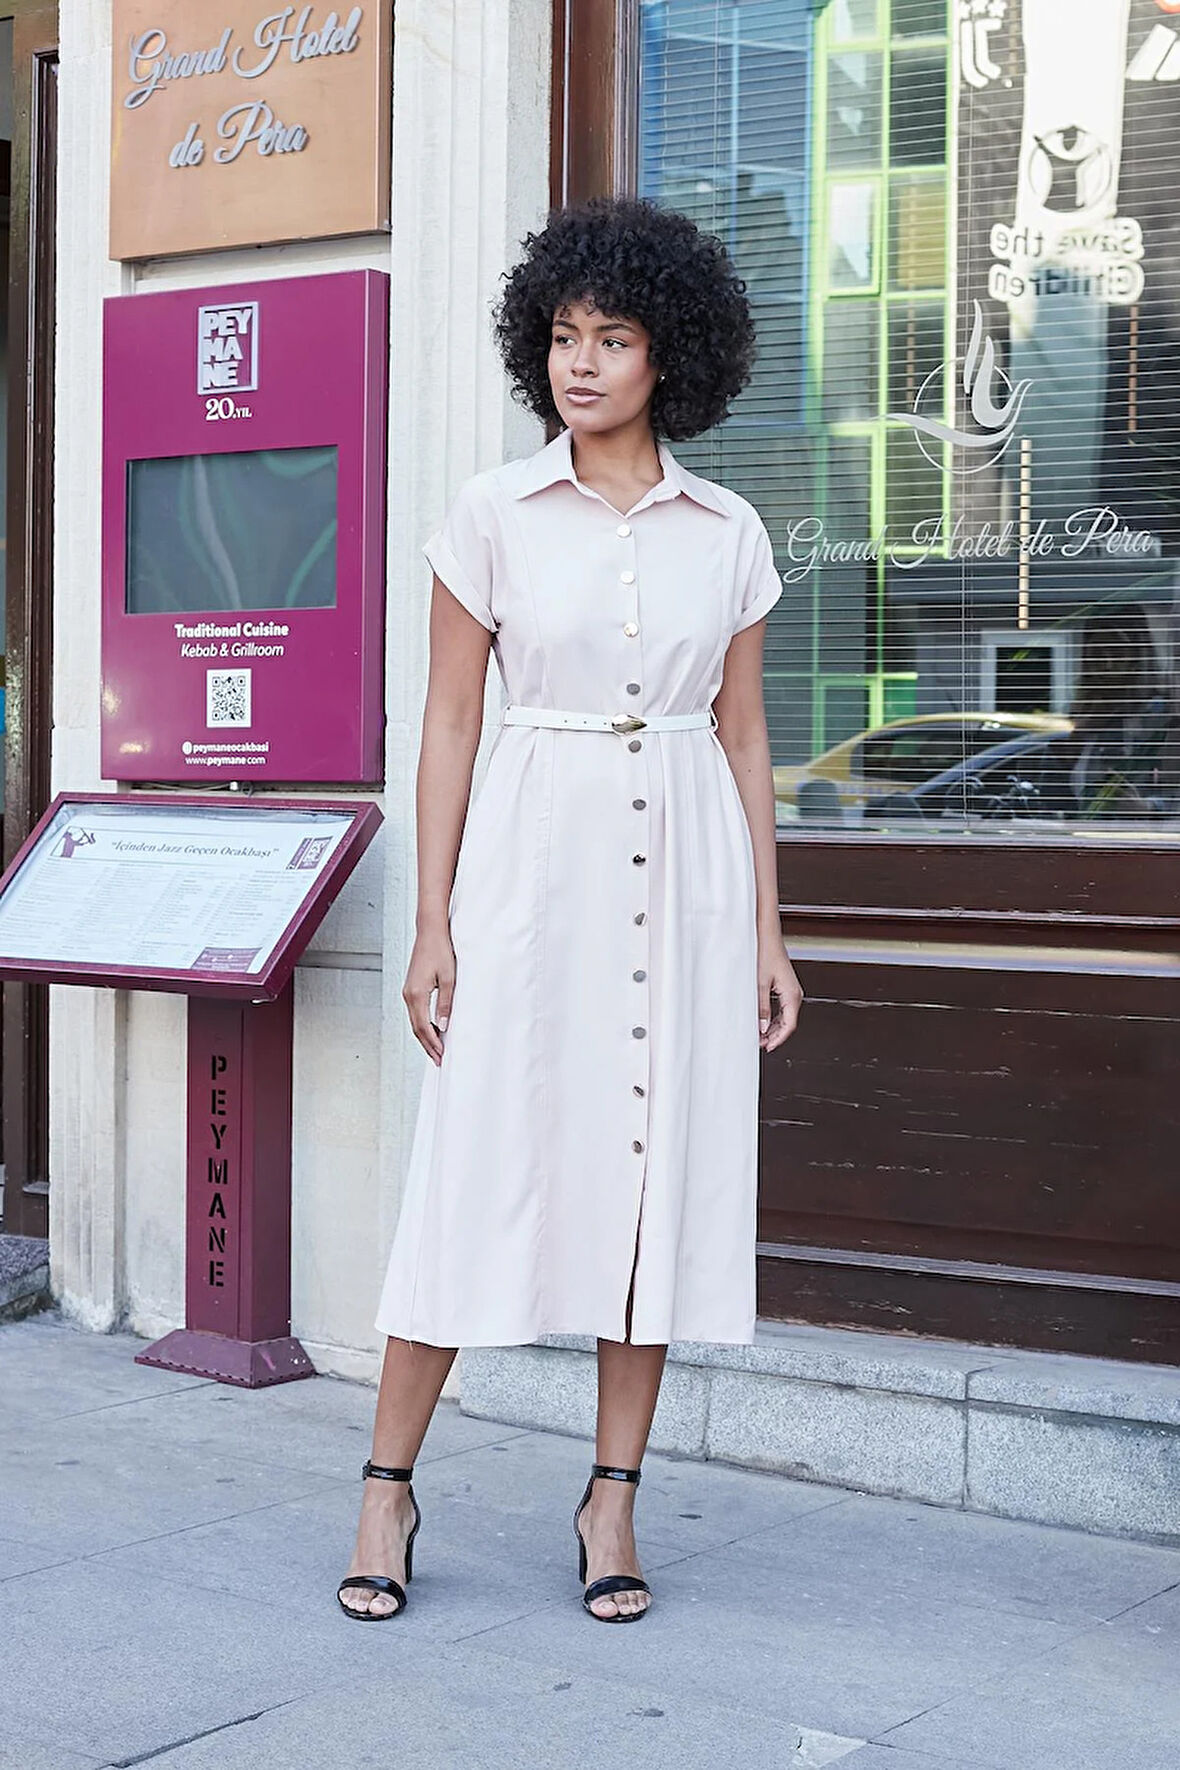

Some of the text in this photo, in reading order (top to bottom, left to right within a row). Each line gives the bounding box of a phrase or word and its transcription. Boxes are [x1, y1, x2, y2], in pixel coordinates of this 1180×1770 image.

[124, 6, 362, 110] Grand Hotel
[169, 99, 309, 168] de Pera
[203, 308, 252, 336] PEY
[203, 336, 243, 362] MA
[203, 361, 239, 388] NE
[783, 506, 1154, 583] Grand Hotel de Pera
[174, 621, 289, 638] Traditional Cuisine
[181, 641, 284, 657] Kebab & Grillroom
[185, 756, 266, 767] www.peymane.com
[207, 1055, 228, 1288] PEYMANE
